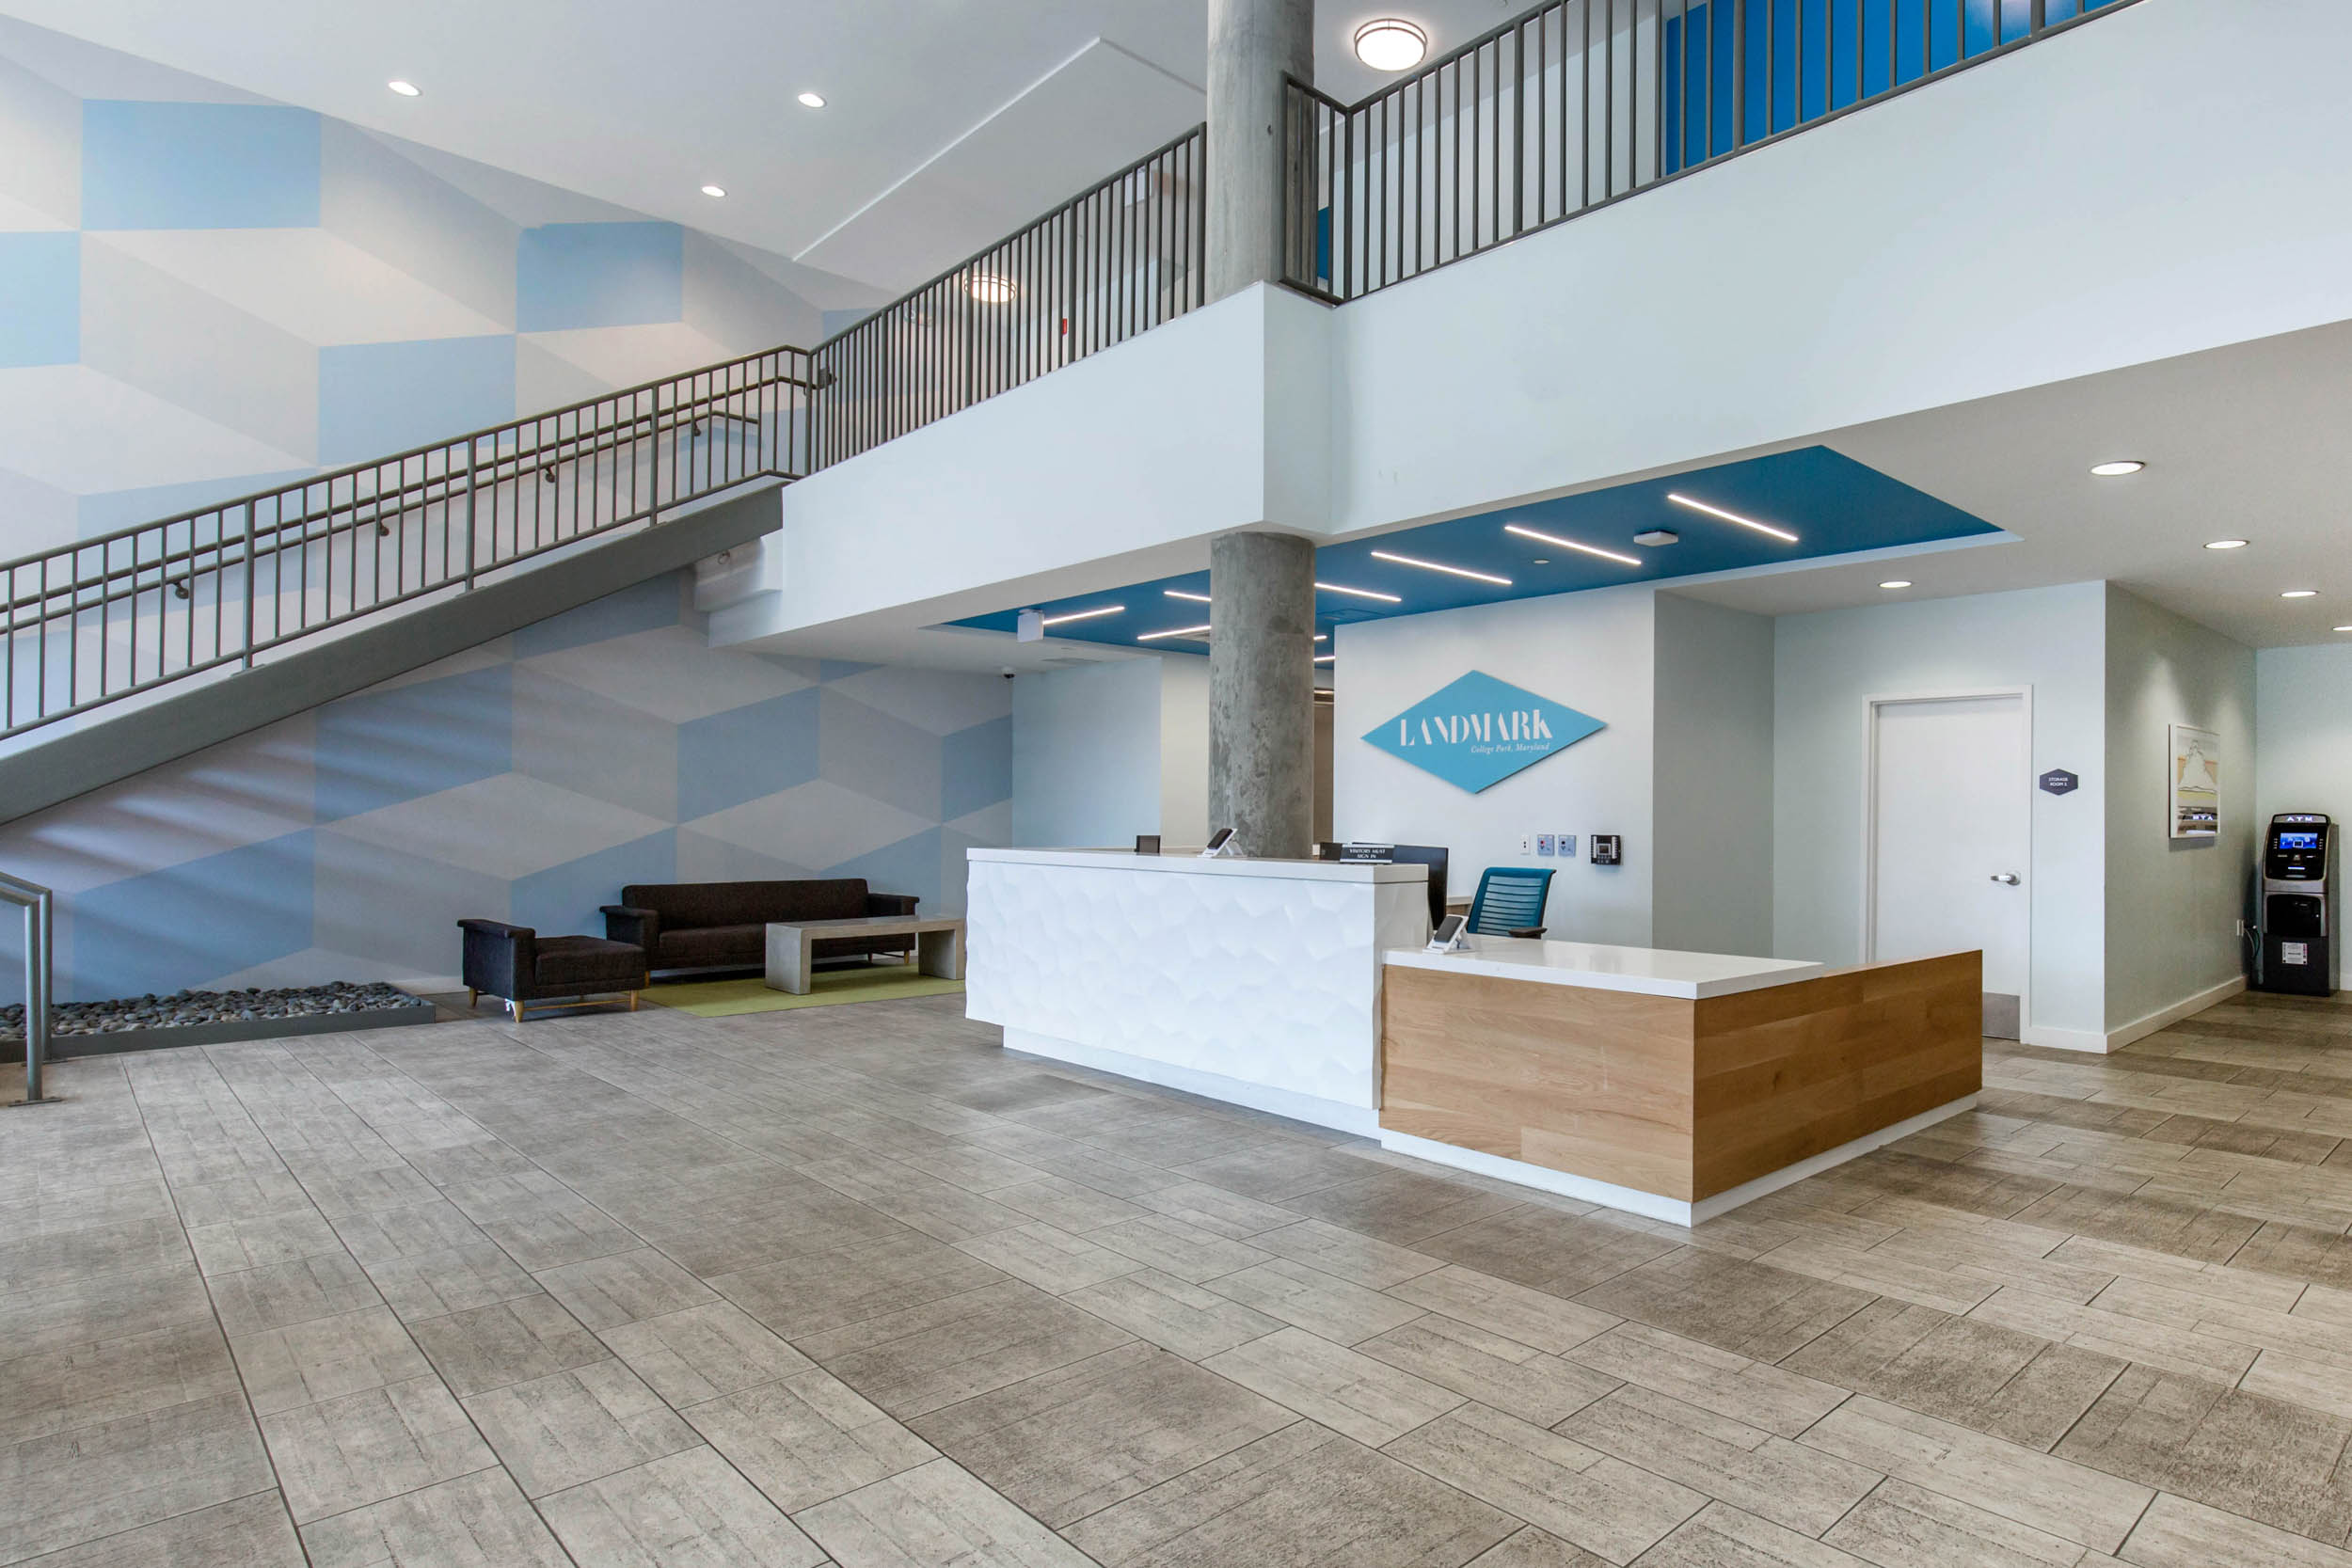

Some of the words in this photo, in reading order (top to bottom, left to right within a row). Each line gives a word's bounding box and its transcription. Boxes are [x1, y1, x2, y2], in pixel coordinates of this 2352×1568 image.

[1400, 709, 1552, 746] LANDMARK
[1470, 744, 1494, 755] College
[1496, 744, 1513, 752] Park,
[1516, 742, 1550, 752] Maryland
